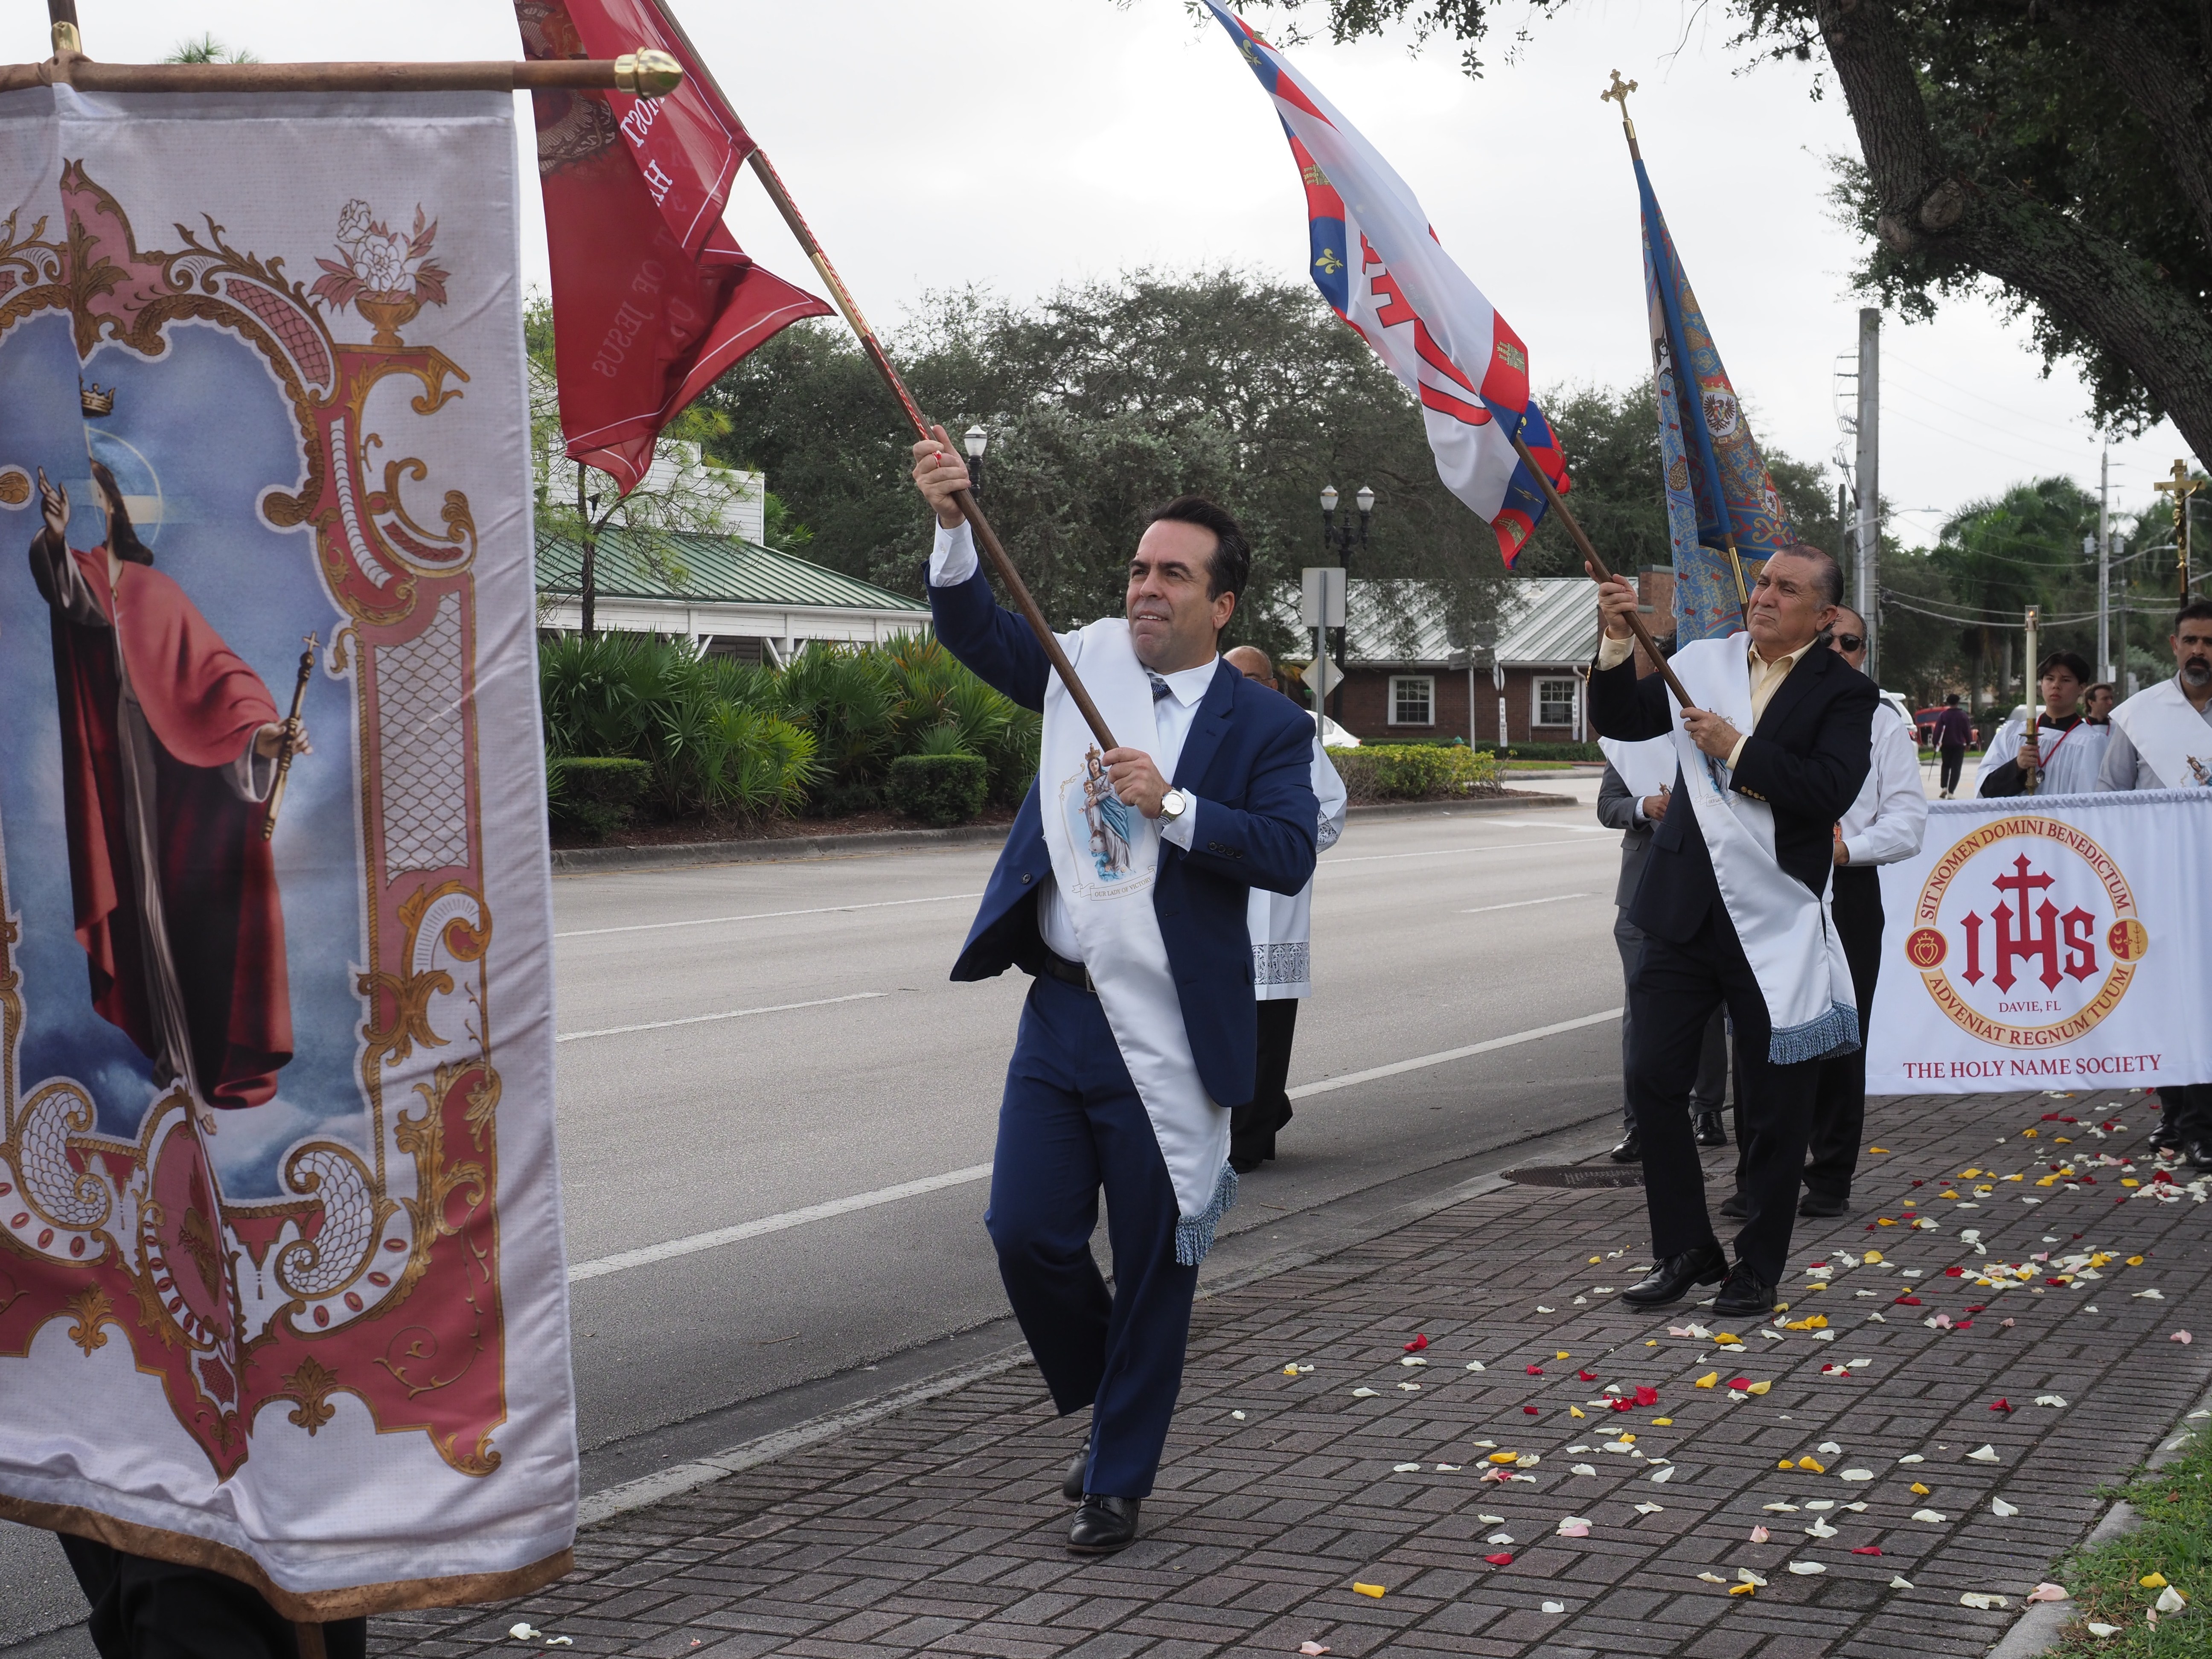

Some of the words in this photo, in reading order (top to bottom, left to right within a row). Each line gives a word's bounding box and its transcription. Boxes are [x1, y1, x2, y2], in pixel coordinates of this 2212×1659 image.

[1129, 876, 1152, 890] VICTORY
[1921, 891, 1938, 920] SIT
[1930, 836, 1980, 888] NOMEN
[1982, 819, 2043, 845] DOMINI
[2047, 822, 2131, 911] BENEDICTUM
[1960, 852, 2099, 995] IHS
[1929, 977, 2006, 1041] ADVENIAT
[2009, 1015, 2090, 1046] REGNUM
[2087, 968, 2129, 1020] TUUM
[1998, 1001, 2043, 1013] DAVIE,
[2046, 1001, 2061, 1011] FL
[1903, 1062, 1945, 1079] THE
[1950, 1060, 2005, 1078] HOLY
[2010, 1059, 2071, 1076] NAME
[2075, 1054, 2162, 1074] SOCIETY
